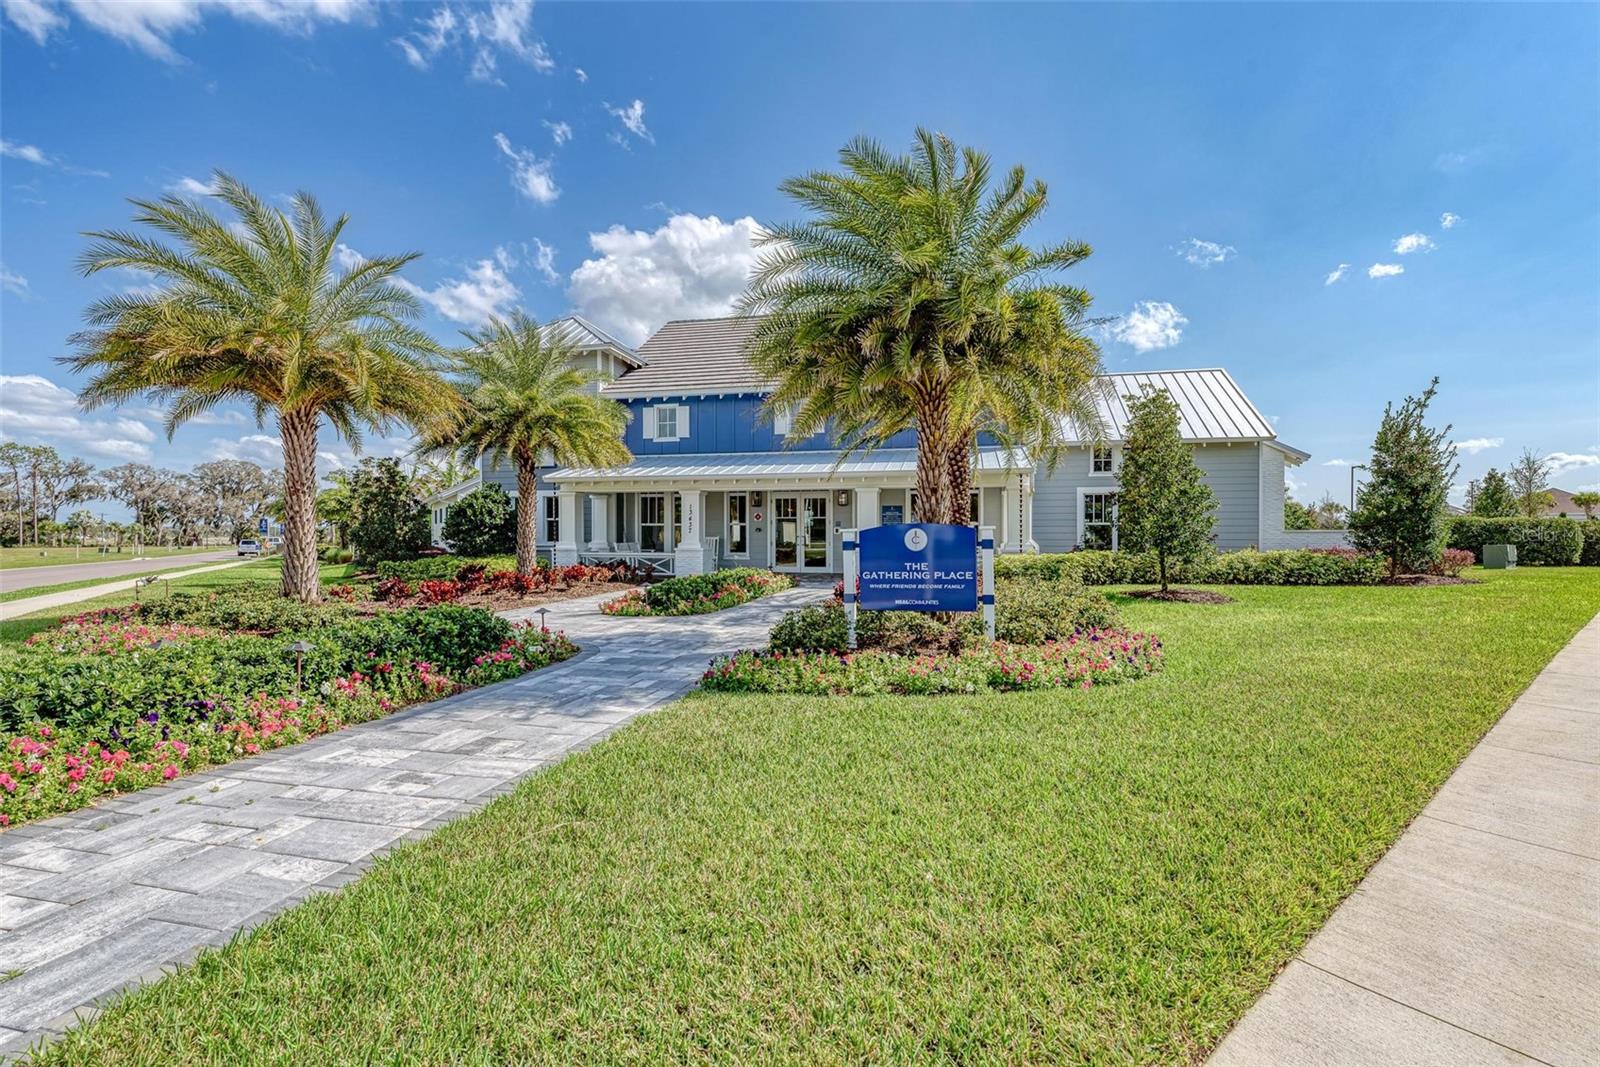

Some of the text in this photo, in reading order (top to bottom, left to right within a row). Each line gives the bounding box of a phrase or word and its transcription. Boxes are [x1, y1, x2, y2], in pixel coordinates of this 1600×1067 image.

[904, 562, 929, 571] THE
[862, 571, 973, 580] GATHERING PLACE
